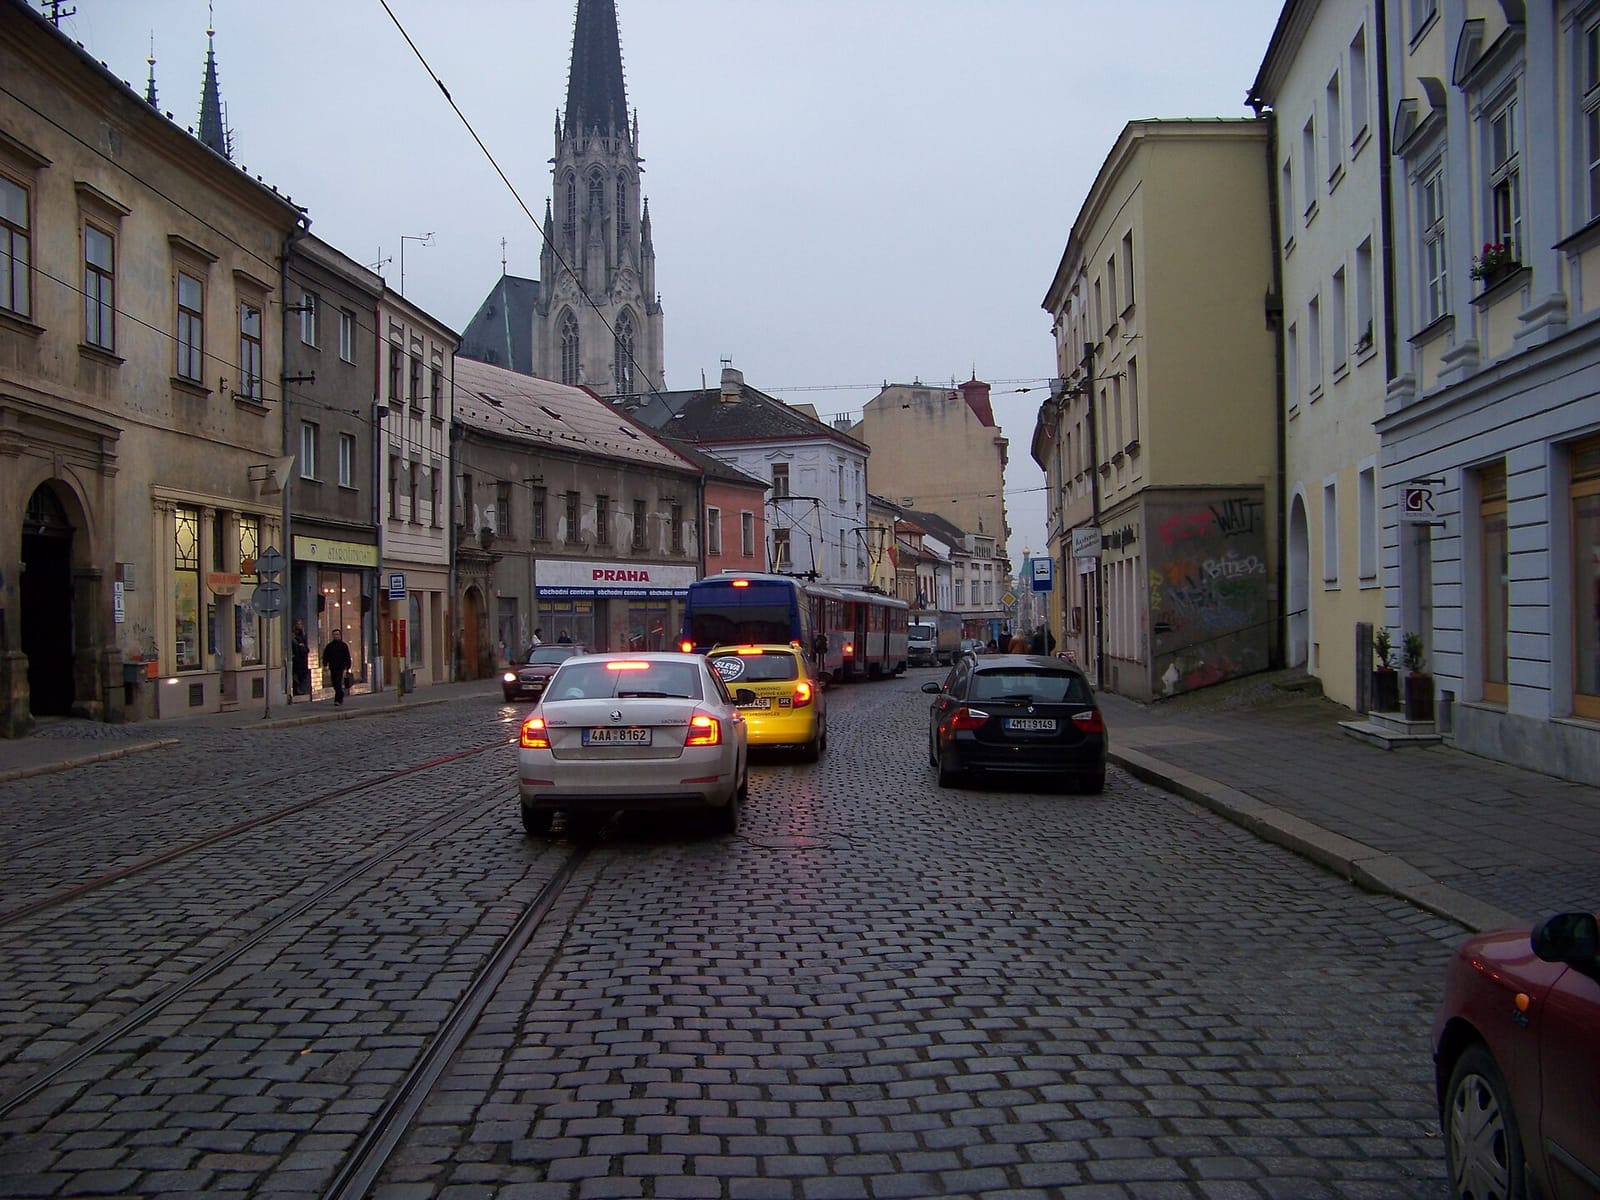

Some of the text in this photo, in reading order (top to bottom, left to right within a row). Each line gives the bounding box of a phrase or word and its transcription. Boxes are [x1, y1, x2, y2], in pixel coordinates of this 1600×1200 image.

[592, 569, 650, 582] PRAHA
[715, 661, 740, 671] SLEVA
[1011, 719, 1053, 728] 4M1 9149
[591, 729, 646, 741] 4AA 8162
